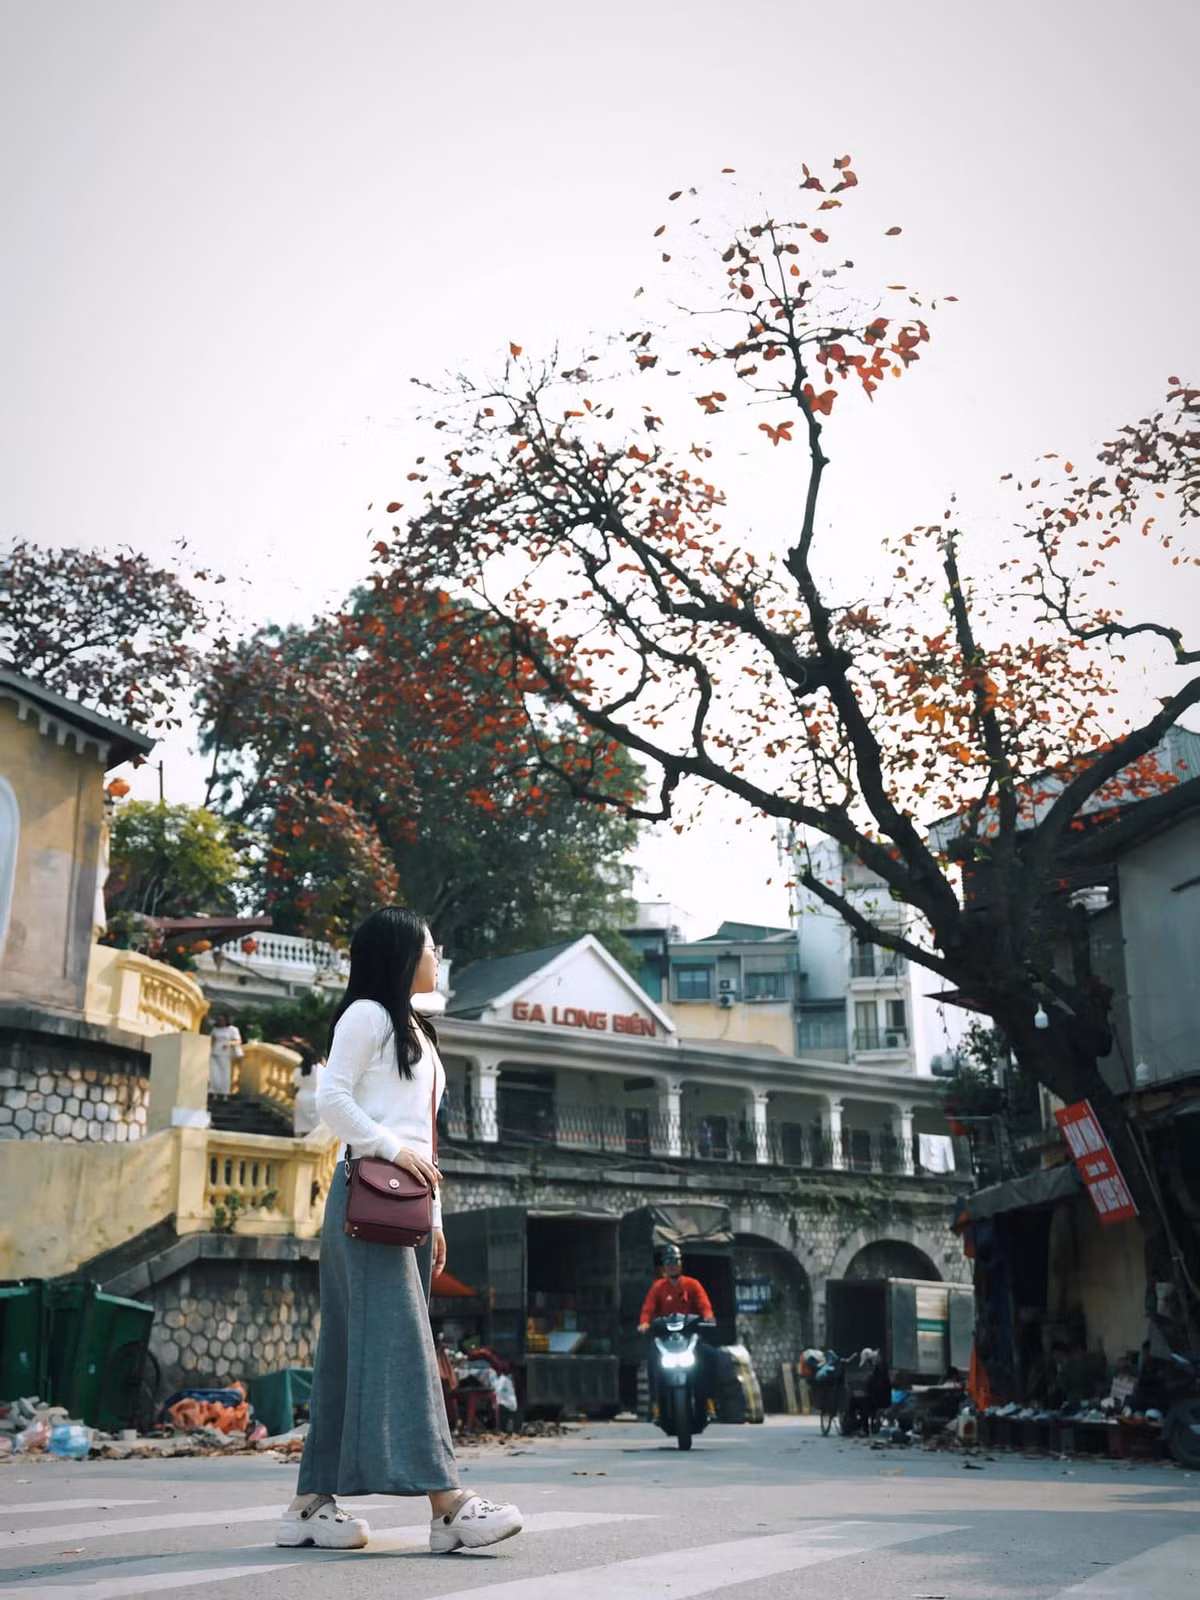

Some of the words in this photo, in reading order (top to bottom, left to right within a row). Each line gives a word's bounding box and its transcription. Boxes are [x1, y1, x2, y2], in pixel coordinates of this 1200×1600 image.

[512, 1001, 546, 1023] GA
[552, 1006, 607, 1031] LONG
[613, 1012, 657, 1037] BIÊN
